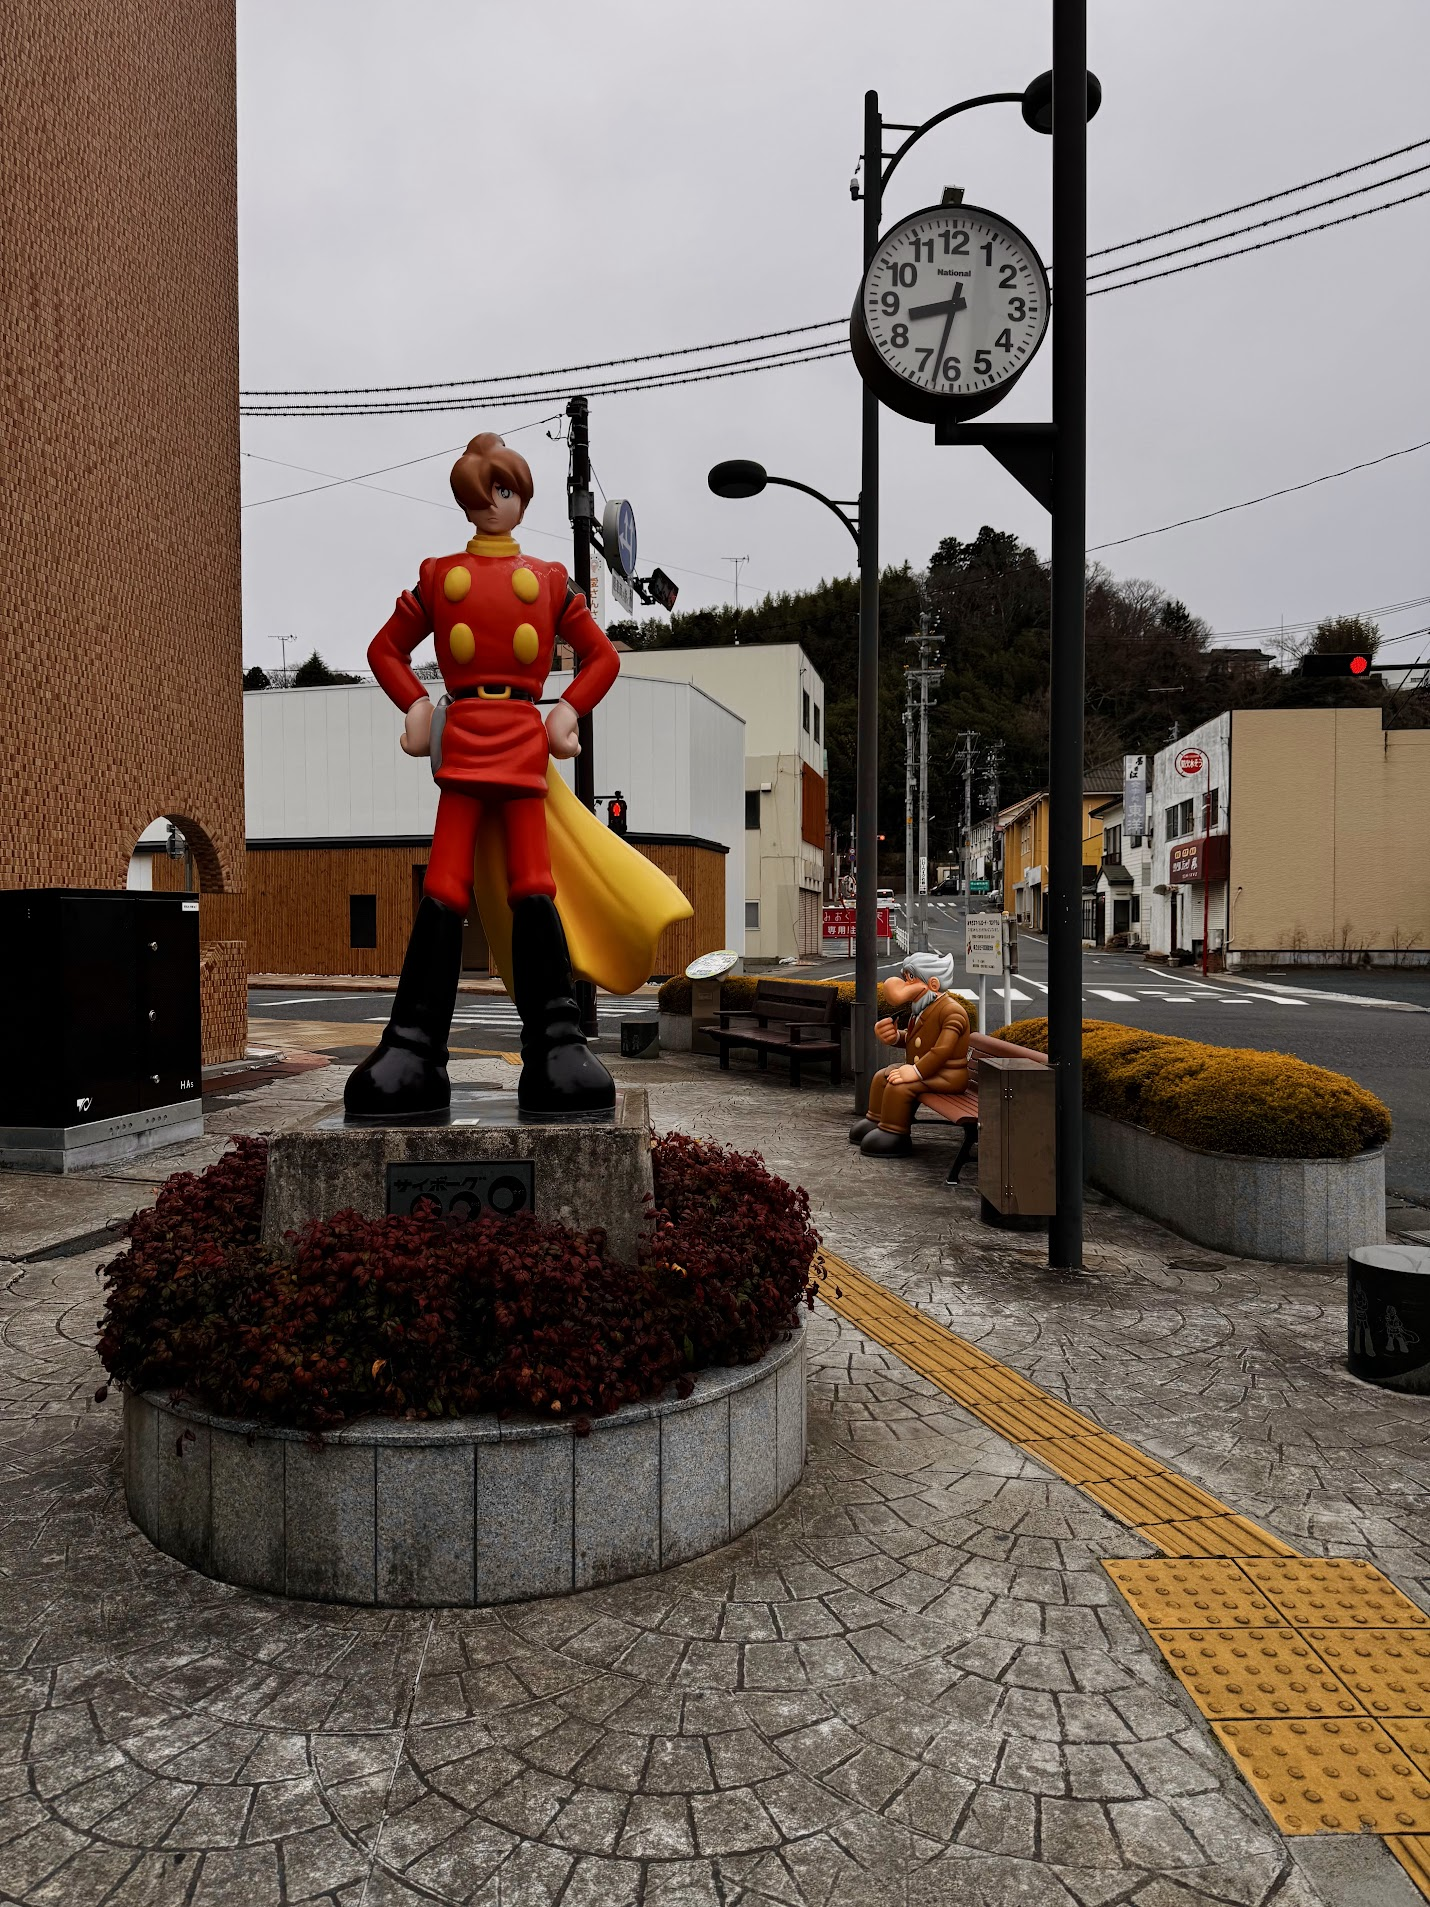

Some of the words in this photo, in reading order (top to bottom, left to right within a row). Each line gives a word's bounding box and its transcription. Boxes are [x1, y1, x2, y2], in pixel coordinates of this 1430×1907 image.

[909, 238, 934, 263] 11
[938, 230, 970, 255] 12
[980, 242, 993, 266] 1
[886, 262, 917, 288] 10
[937, 268, 971, 277] National
[998, 264, 1017, 289] 2
[881, 291, 900, 316] 9
[1007, 297, 1026, 322] 3
[890, 323, 909, 348] 8
[994, 328, 1013, 352] 4
[915, 348, 934, 372] 7
[942, 357, 961, 382] 6
[973, 350, 992, 374] 5
[394, 1176, 487, 1192] サイボーグ
